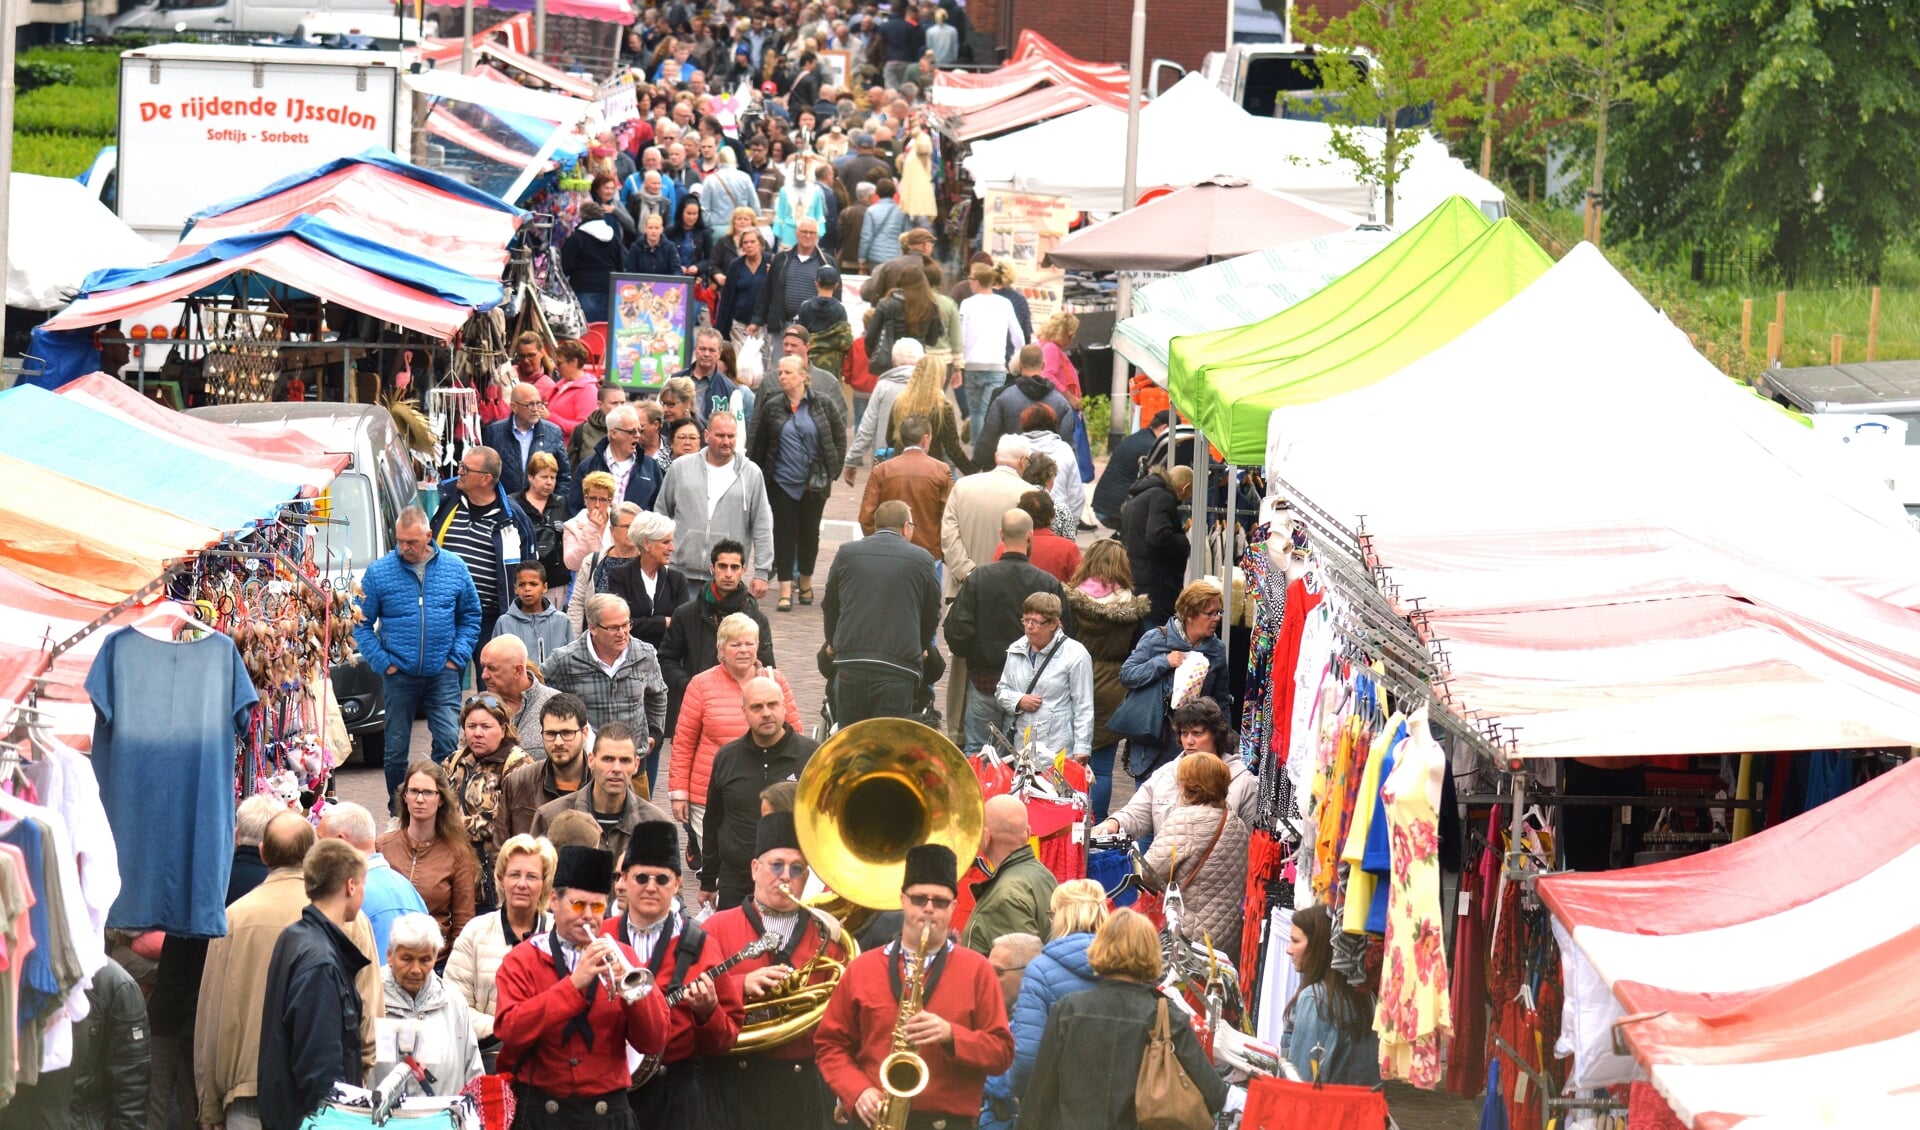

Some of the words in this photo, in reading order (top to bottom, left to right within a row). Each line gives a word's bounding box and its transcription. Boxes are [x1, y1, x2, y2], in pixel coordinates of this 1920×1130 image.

[140, 101, 172, 122] De
[181, 96, 277, 121] rijdende
[286, 98, 377, 131] IJssalon
[207, 128, 248, 144] Softijs
[261, 130, 309, 144] Sorbets
[711, 395, 729, 413] M
